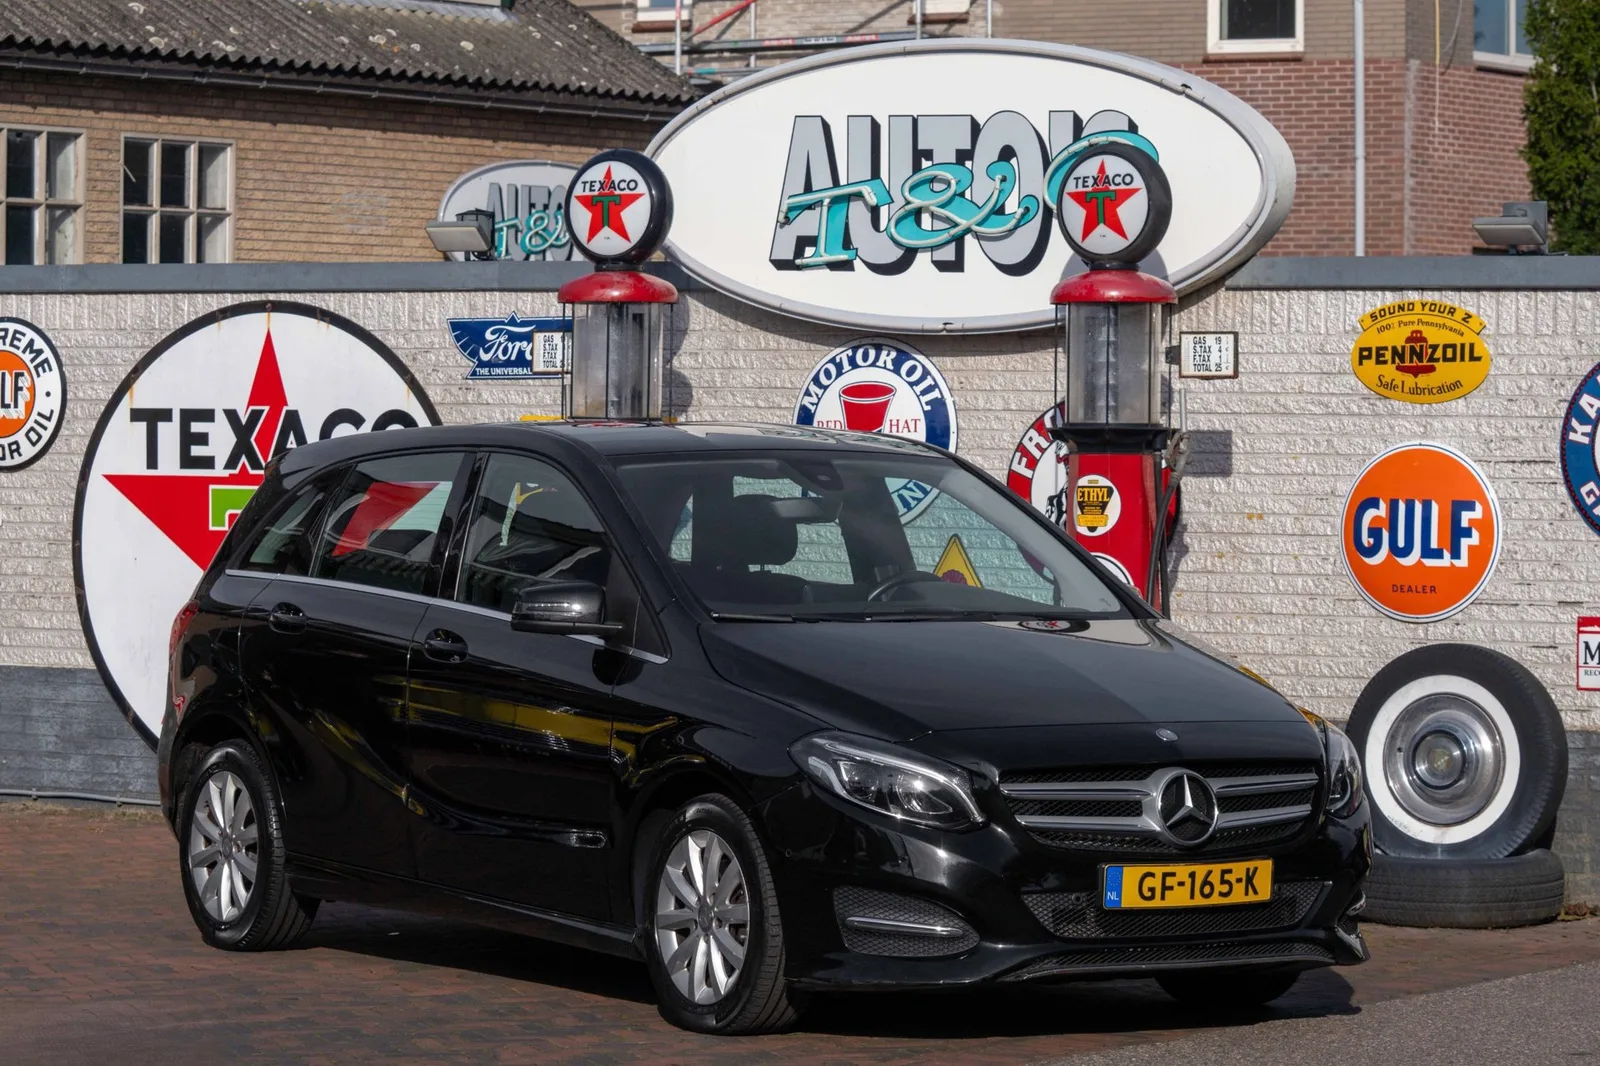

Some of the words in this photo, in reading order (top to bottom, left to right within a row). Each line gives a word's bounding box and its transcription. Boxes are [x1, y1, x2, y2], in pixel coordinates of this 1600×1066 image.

[581, 179, 639, 193] TEXACO
[1073, 173, 1134, 189] TEXACO
[769, 109, 1139, 276] AUTO'
[1369, 302, 1415, 322] SOUND
[1420, 302, 1457, 317] YOUR
[1461, 312, 1473, 324] Z
[1398, 320, 1416, 328] Pure
[1417, 318, 1465, 337] Pennsylvania
[479, 325, 536, 361] For
[543, 334, 554, 343] GAS
[1193, 336, 1207, 345] GAS
[1193, 345, 1212, 354] S.TAX
[1358, 342, 1482, 366] PENNZOIL
[543, 360, 558, 369] TOTAL
[1193, 354, 1211, 363] F.TAX
[491, 367, 532, 376] UNIVERSAL
[1193, 363, 1212, 372] TOTAL
[1214, 363, 1222, 372] 25
[801, 345, 897, 413] MOTOR
[900, 359, 943, 411] OIL
[1376, 374, 1399, 392] Safe
[1401, 380, 1463, 396] Lubrication
[24, 408, 54, 448] OIL
[889, 419, 921, 433] HAT
[1077, 487, 1110, 502] ETHYL
[1353, 496, 1483, 568] GULF
[1392, 584, 1437, 594] DEALER
[1107, 891, 1119, 901] NL
[1138, 866, 1259, 902] GF-165-K
